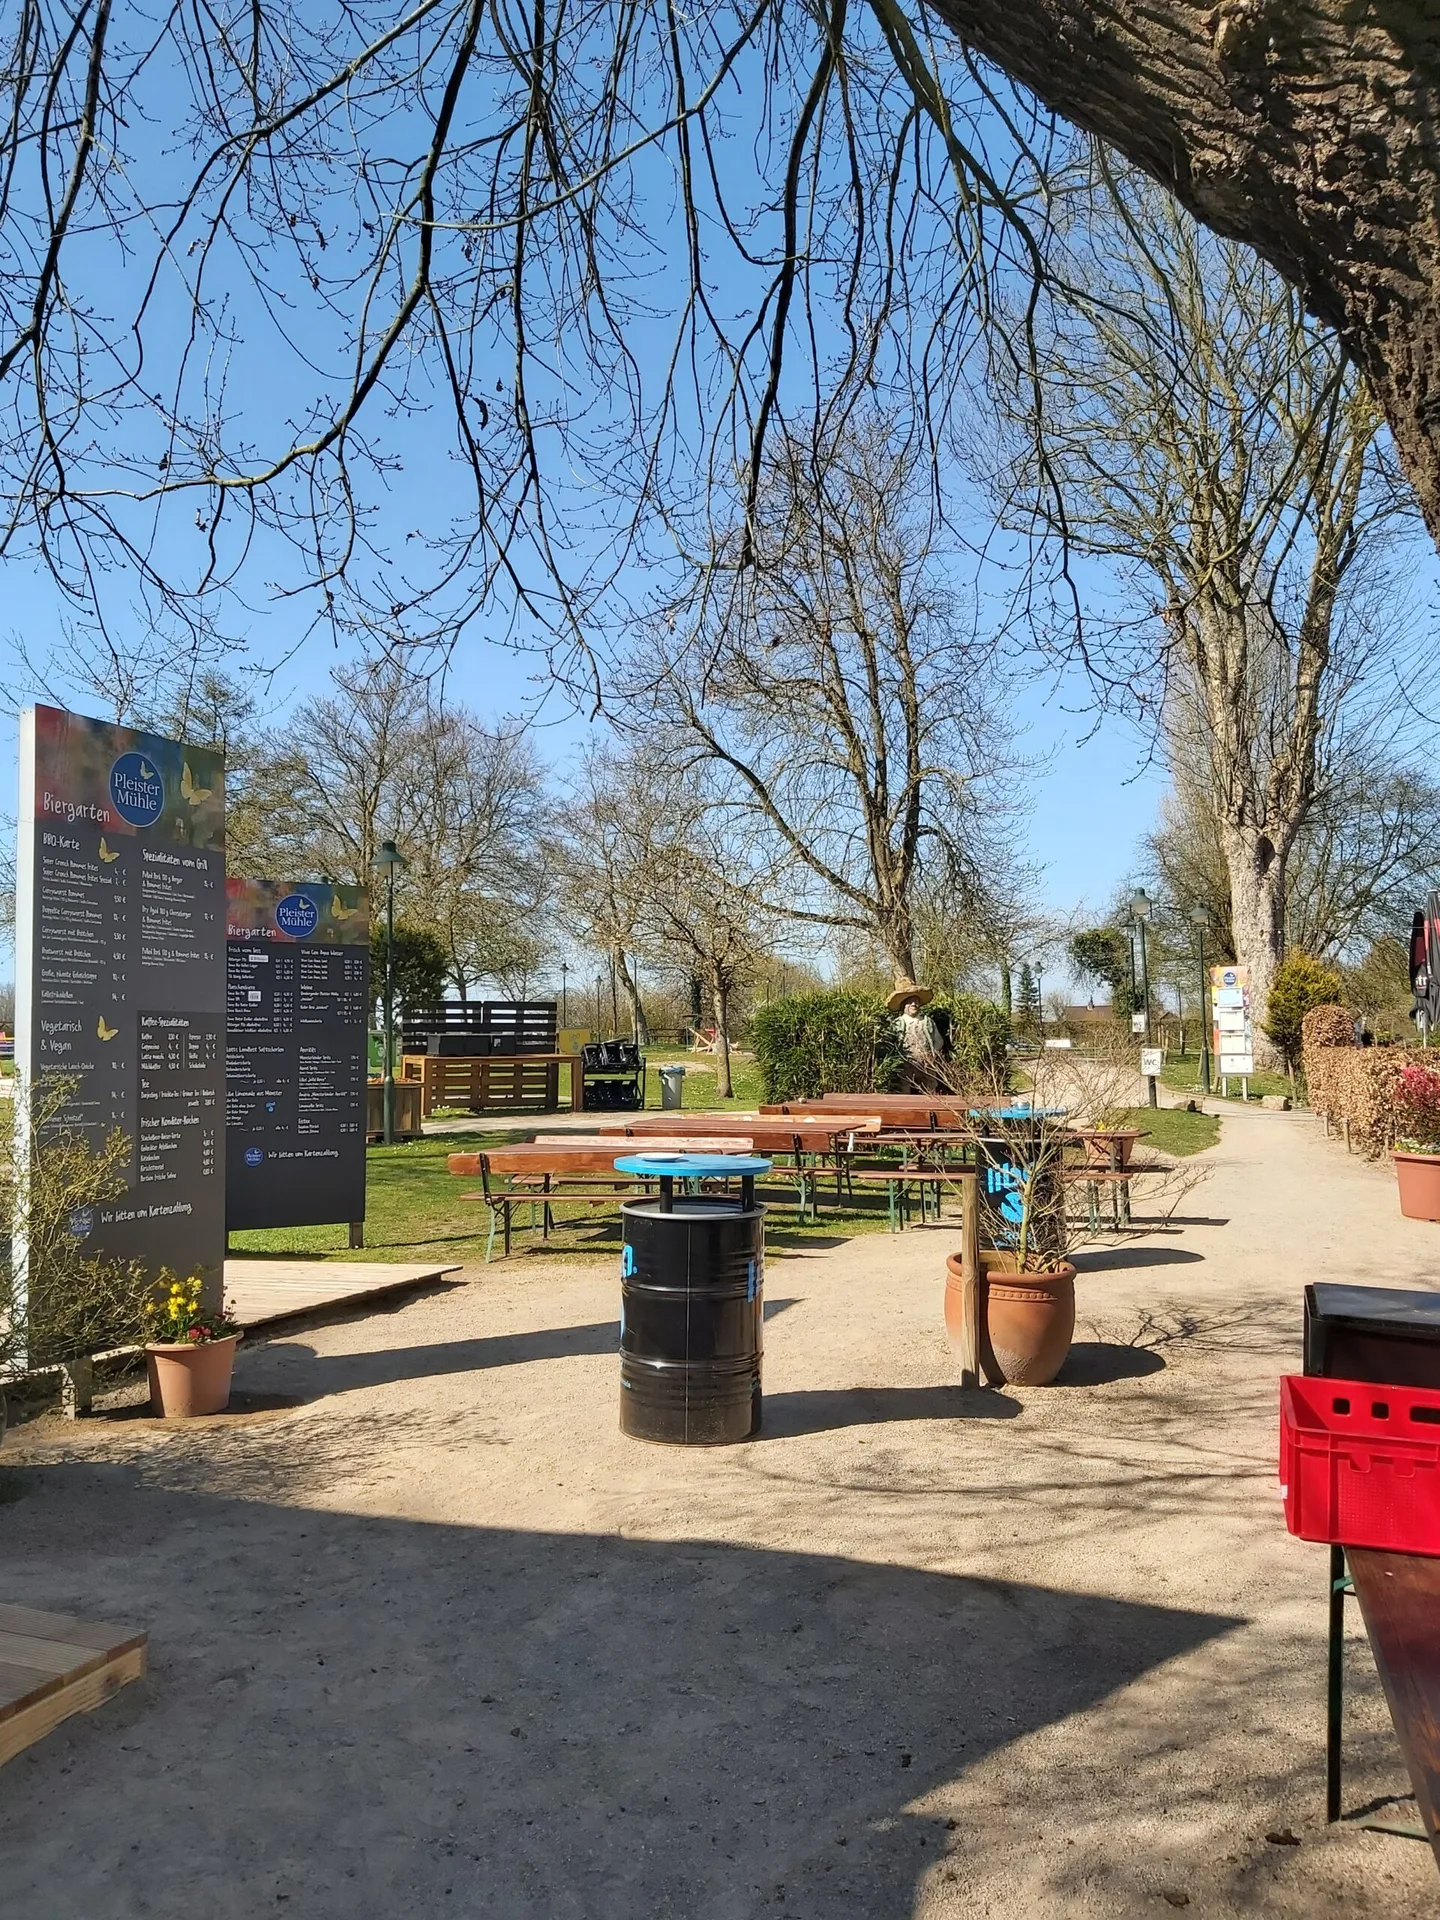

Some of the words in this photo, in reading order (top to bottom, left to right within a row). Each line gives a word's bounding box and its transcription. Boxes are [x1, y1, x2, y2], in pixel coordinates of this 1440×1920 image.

[114, 772, 160, 796] Pleister
[44, 792, 110, 822] Biergarten
[117, 790, 157, 811] Mühle
[43, 832, 79, 850] BBQ-Karte
[196, 858, 207, 870] Grill
[280, 908, 314, 918] Pleister
[281, 917, 312, 926] Mühle
[228, 924, 276, 940] Biergarten
[41, 1020, 82, 1035] Vegetarisch
[41, 1039, 47, 1050] &
[50, 1040, 71, 1054] Vegan
[1144, 1057, 1158, 1066] WC
[101, 1212, 113, 1223] Wir
[115, 1208, 135, 1222] bitten
[137, 1208, 147, 1218] um
